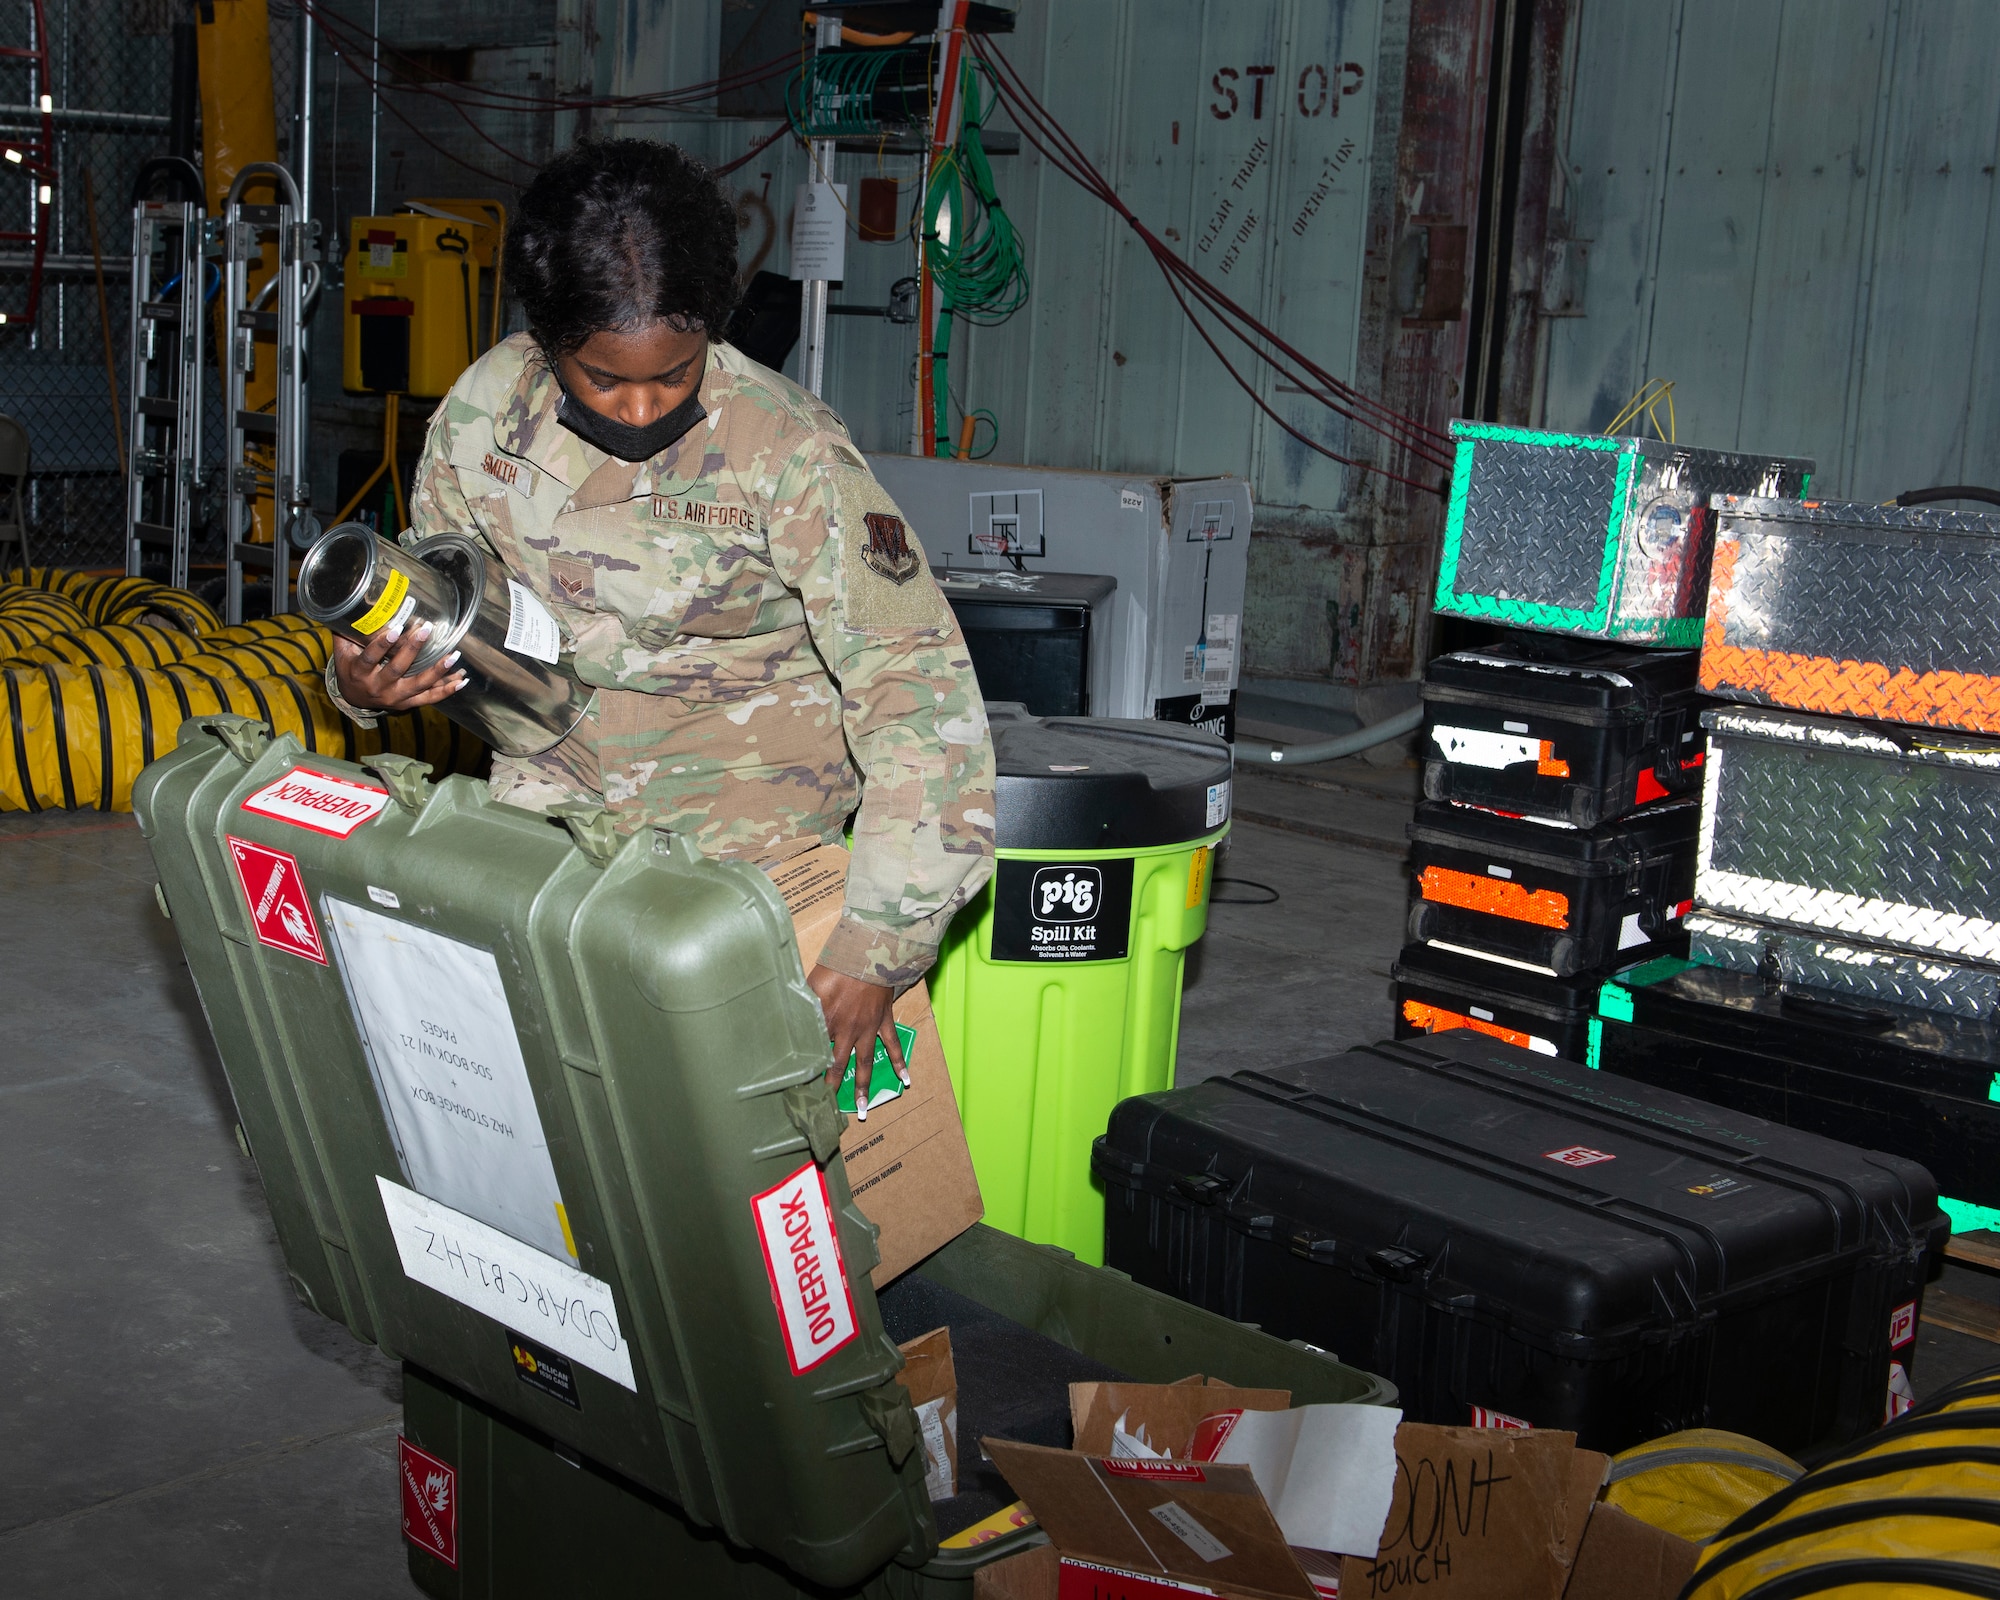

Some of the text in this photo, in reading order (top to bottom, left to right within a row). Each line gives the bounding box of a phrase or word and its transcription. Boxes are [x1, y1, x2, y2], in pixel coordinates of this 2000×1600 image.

[1198, 137, 1269, 253] CLEAR TRACK
[1292, 138, 1355, 236] OPERATION
[1219, 208, 1260, 275] BEFORE
[483, 452, 518, 485] SMITH
[653, 498, 754, 532] U.S. AIR FORCE
[1122, 497, 1142, 507] A226
[266, 781, 372, 819] OVERPACK
[234, 846, 246, 861] 3
[266, 859, 286, 904] FLAMMABLE
[1040, 872, 1094, 915] pig
[1030, 944, 1056, 952] Absorbs
[1031, 925, 1096, 944] Spill Kit
[420, 1019, 457, 1044] PAGES
[399, 1033, 493, 1081] SDS BOOK W/ 21
[1487, 1056, 1528, 1072] Case
[410, 1085, 514, 1139] HAZ STORAGE BOX
[844, 1133, 885, 1163] SHIPPING NAME
[851, 1161, 903, 1198] TIFICATION NUMBER
[779, 1186, 835, 1346] OVERPACK
[537, 1360, 569, 1382] PELICAN
[553, 1377, 570, 1390] CASE
[402, 1460, 446, 1550] FLAMMABLE LIQUID
[404, 1518, 411, 1529] 3
